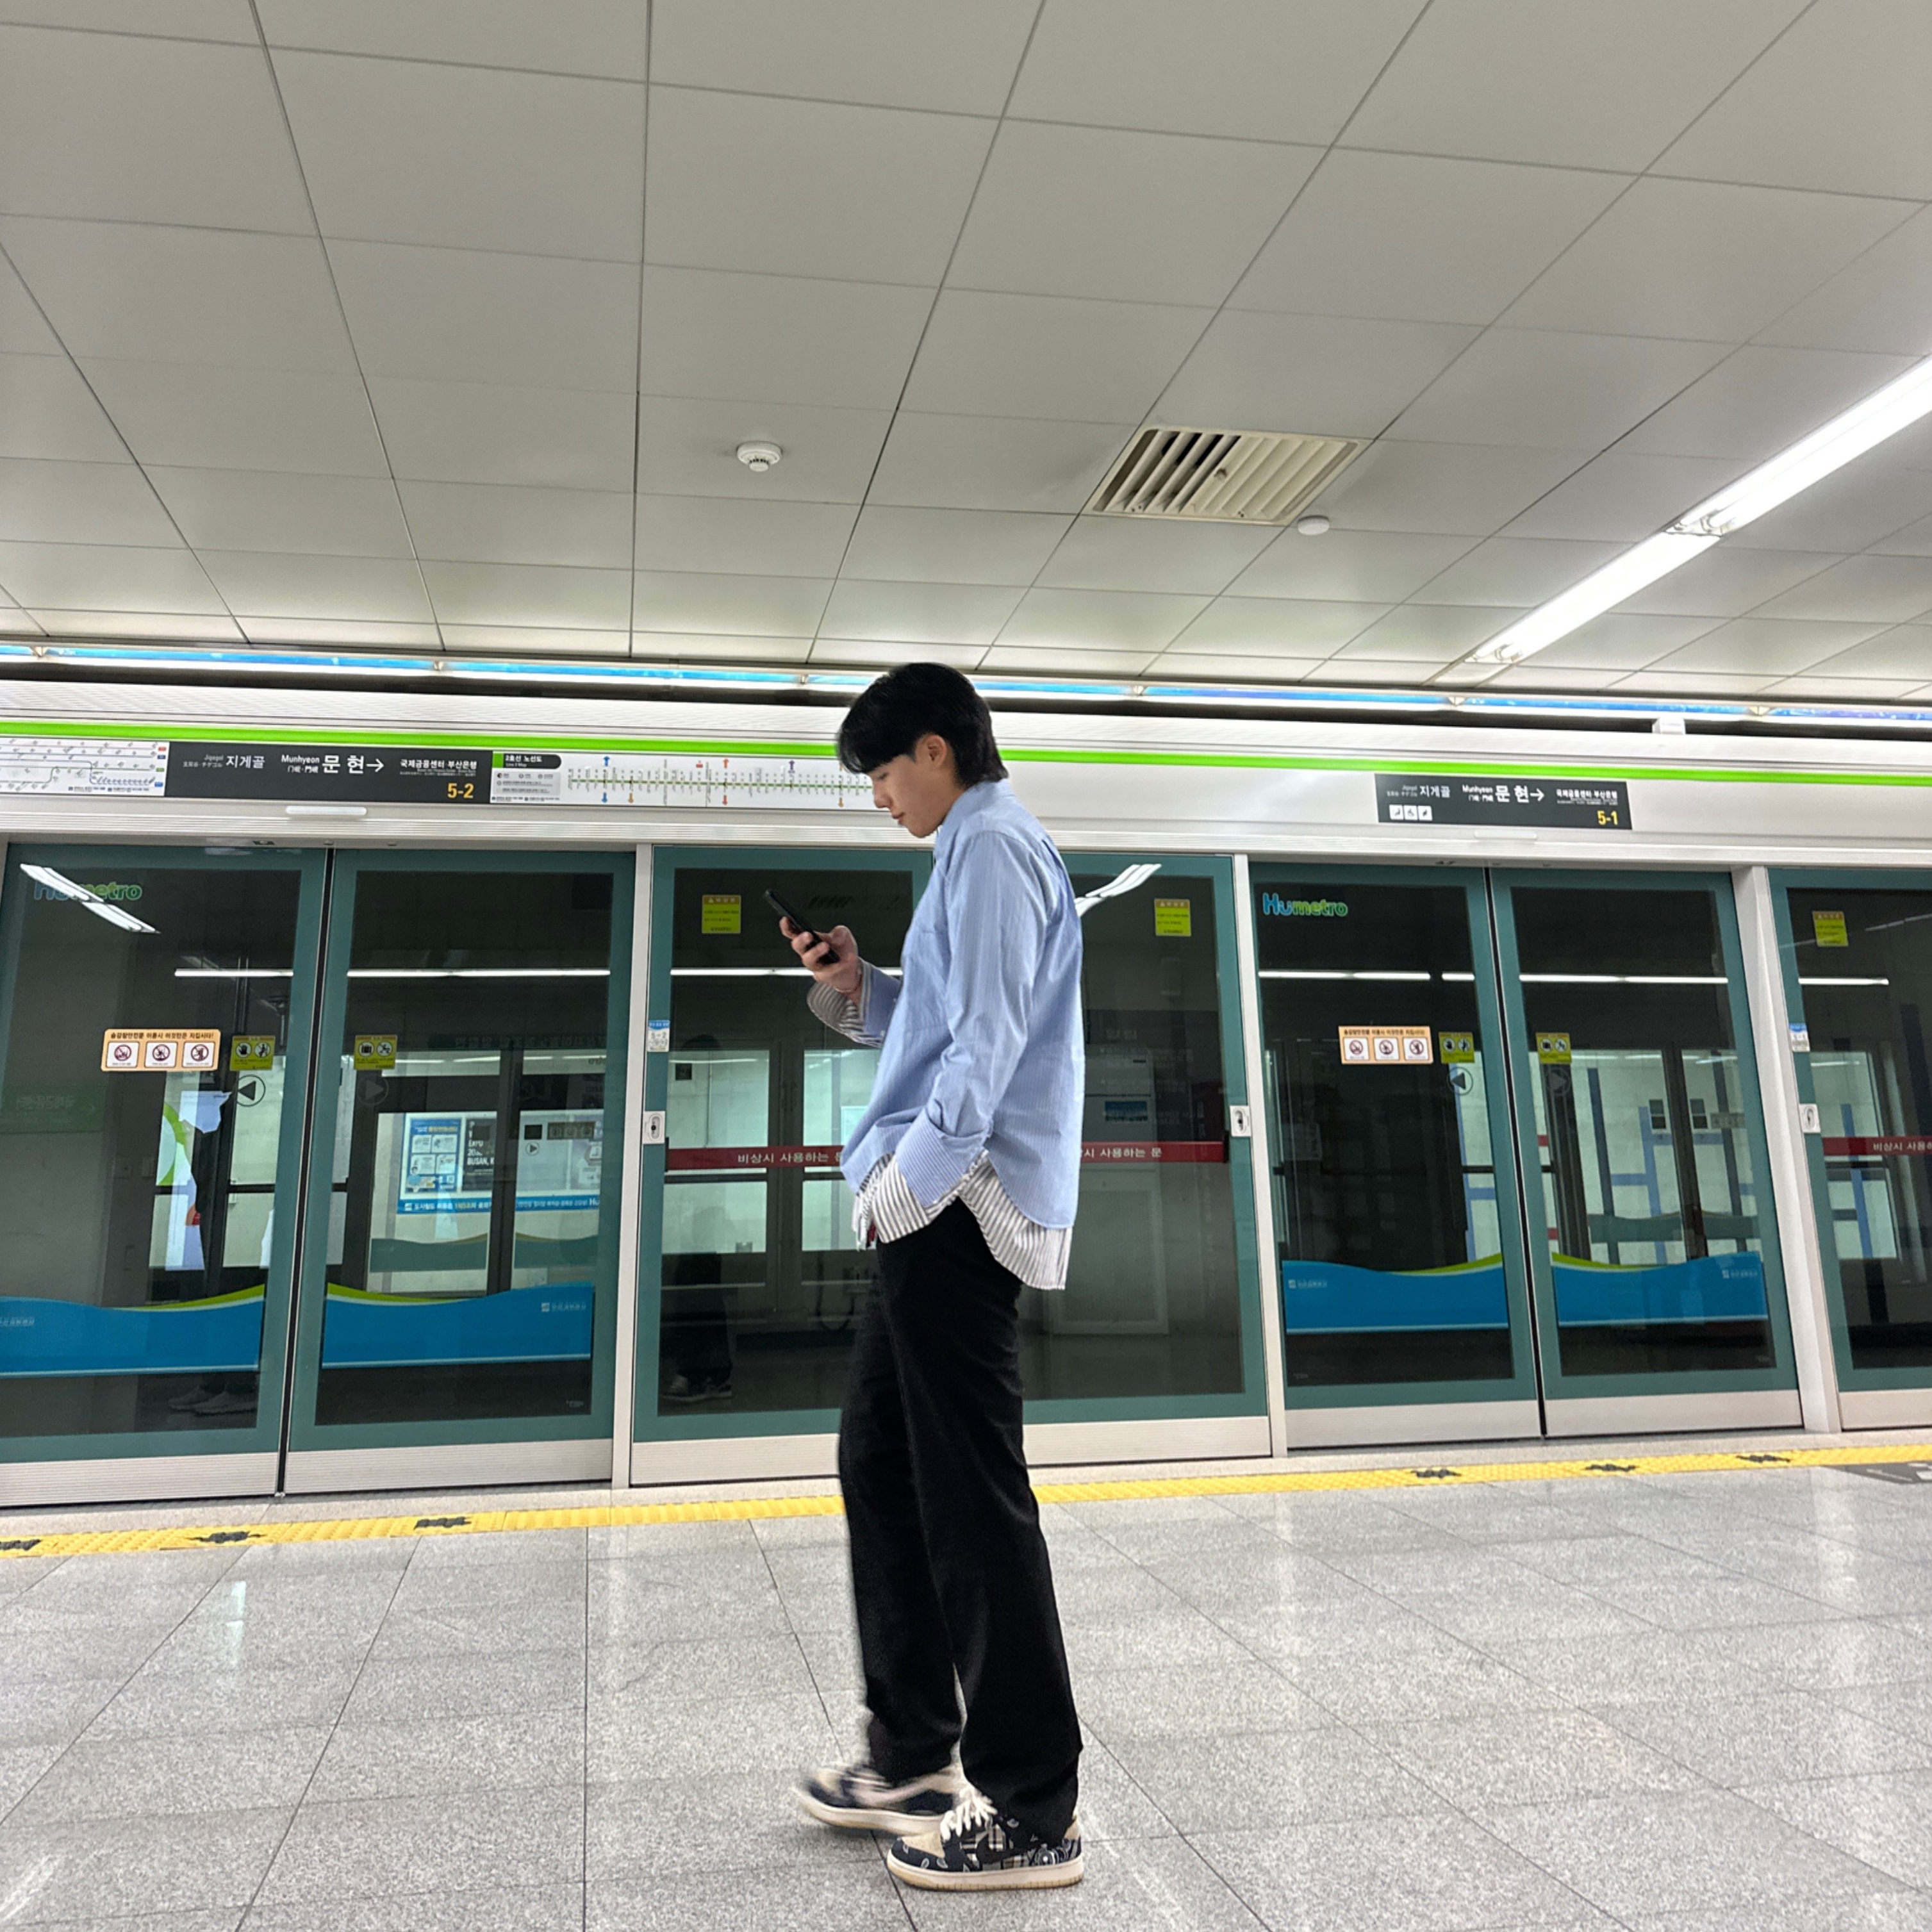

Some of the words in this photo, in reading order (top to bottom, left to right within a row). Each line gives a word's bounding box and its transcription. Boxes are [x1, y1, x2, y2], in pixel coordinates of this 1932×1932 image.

[226, 755, 265, 769] 지게골
[281, 754, 320, 764] Munhyeon
[447, 782, 474, 798] 5-2
[1419, 785, 1450, 798] 지게골
[1597, 810, 1618, 825] 5-1
[1262, 893, 1348, 916] Humetro
[1100, 1148, 1146, 1158] 사용하는
[1151, 1148, 1162, 1158] 문
[1873, 1142, 1903, 1152] 비상시
[738, 1153, 774, 1164] 비상시
[780, 1152, 829, 1163] 사용하는
